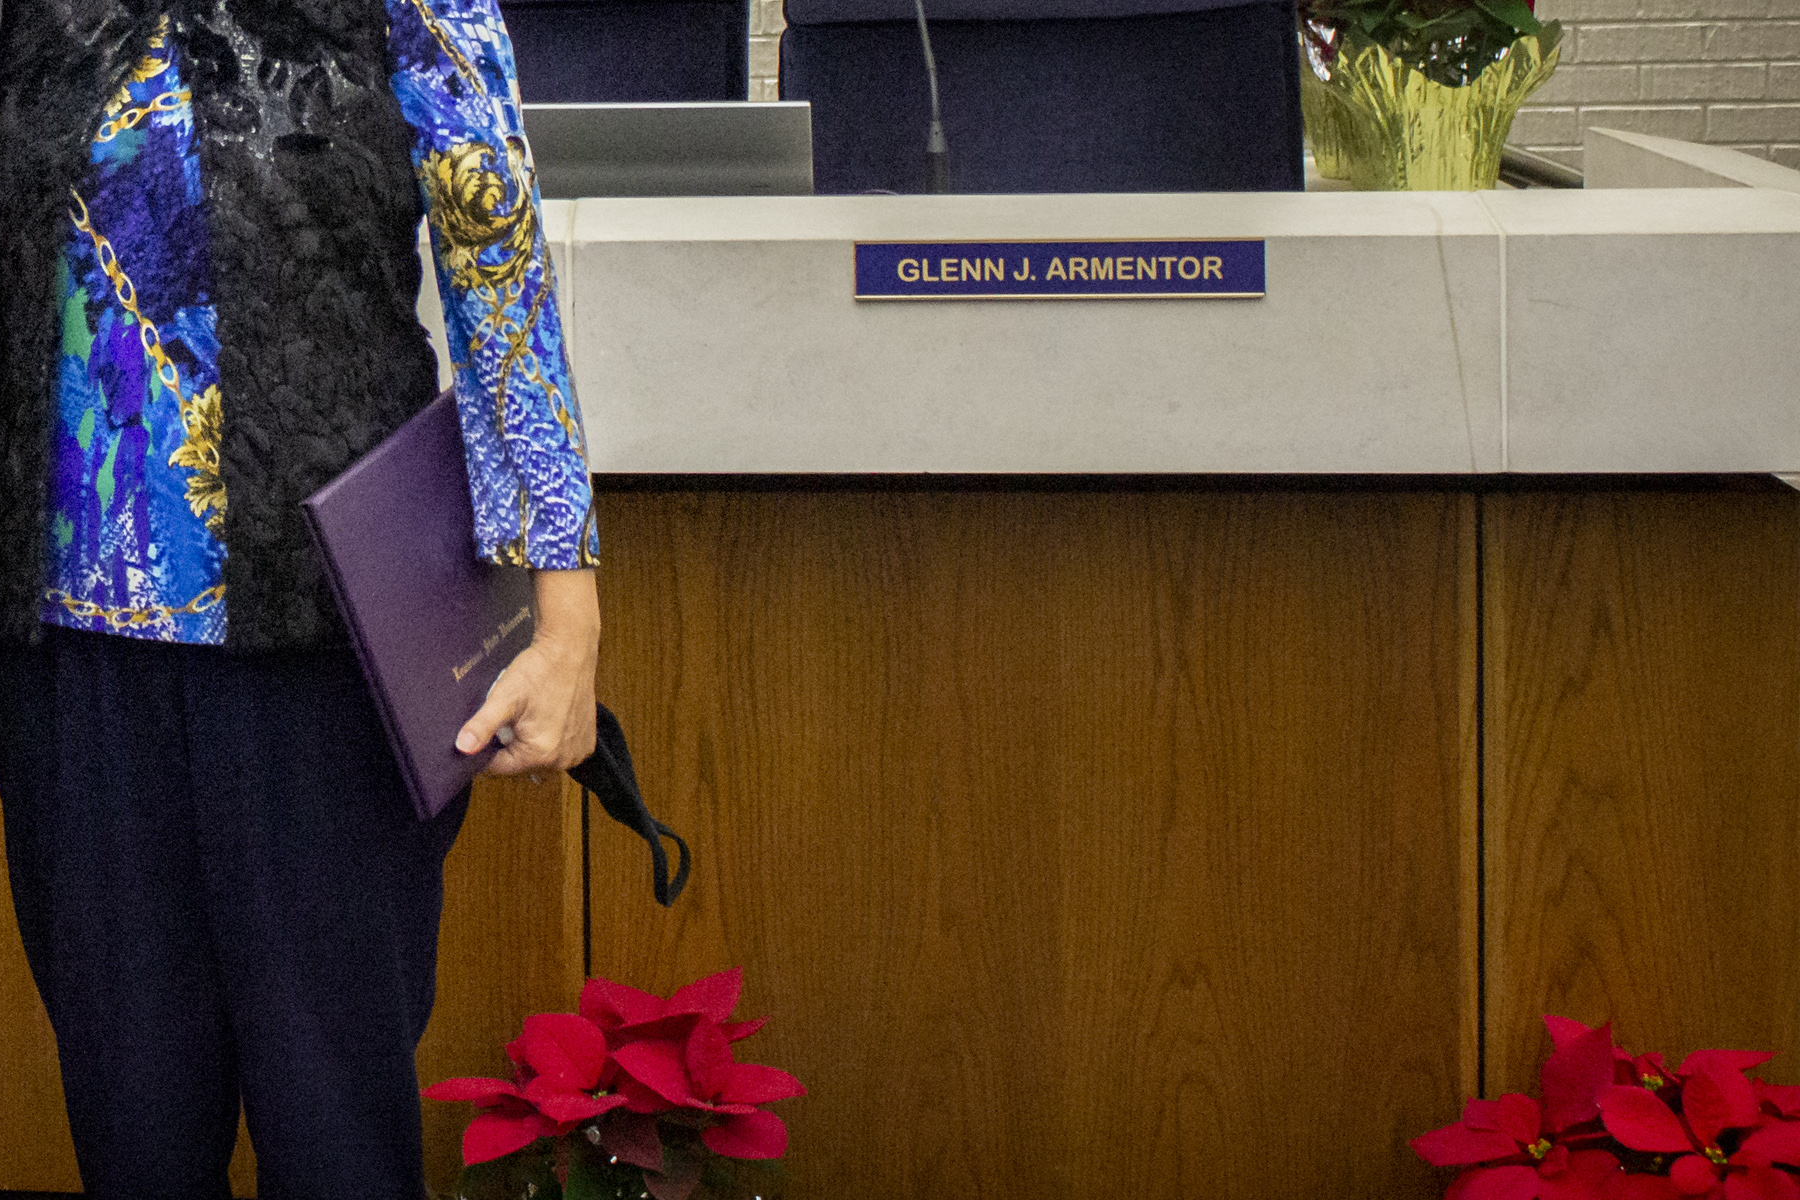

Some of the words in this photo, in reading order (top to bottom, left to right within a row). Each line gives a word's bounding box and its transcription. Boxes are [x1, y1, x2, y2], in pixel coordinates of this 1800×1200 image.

[897, 257, 1005, 283] GLENN
[1013, 257, 1037, 282] J.
[1045, 256, 1224, 281] ARMENTOR
